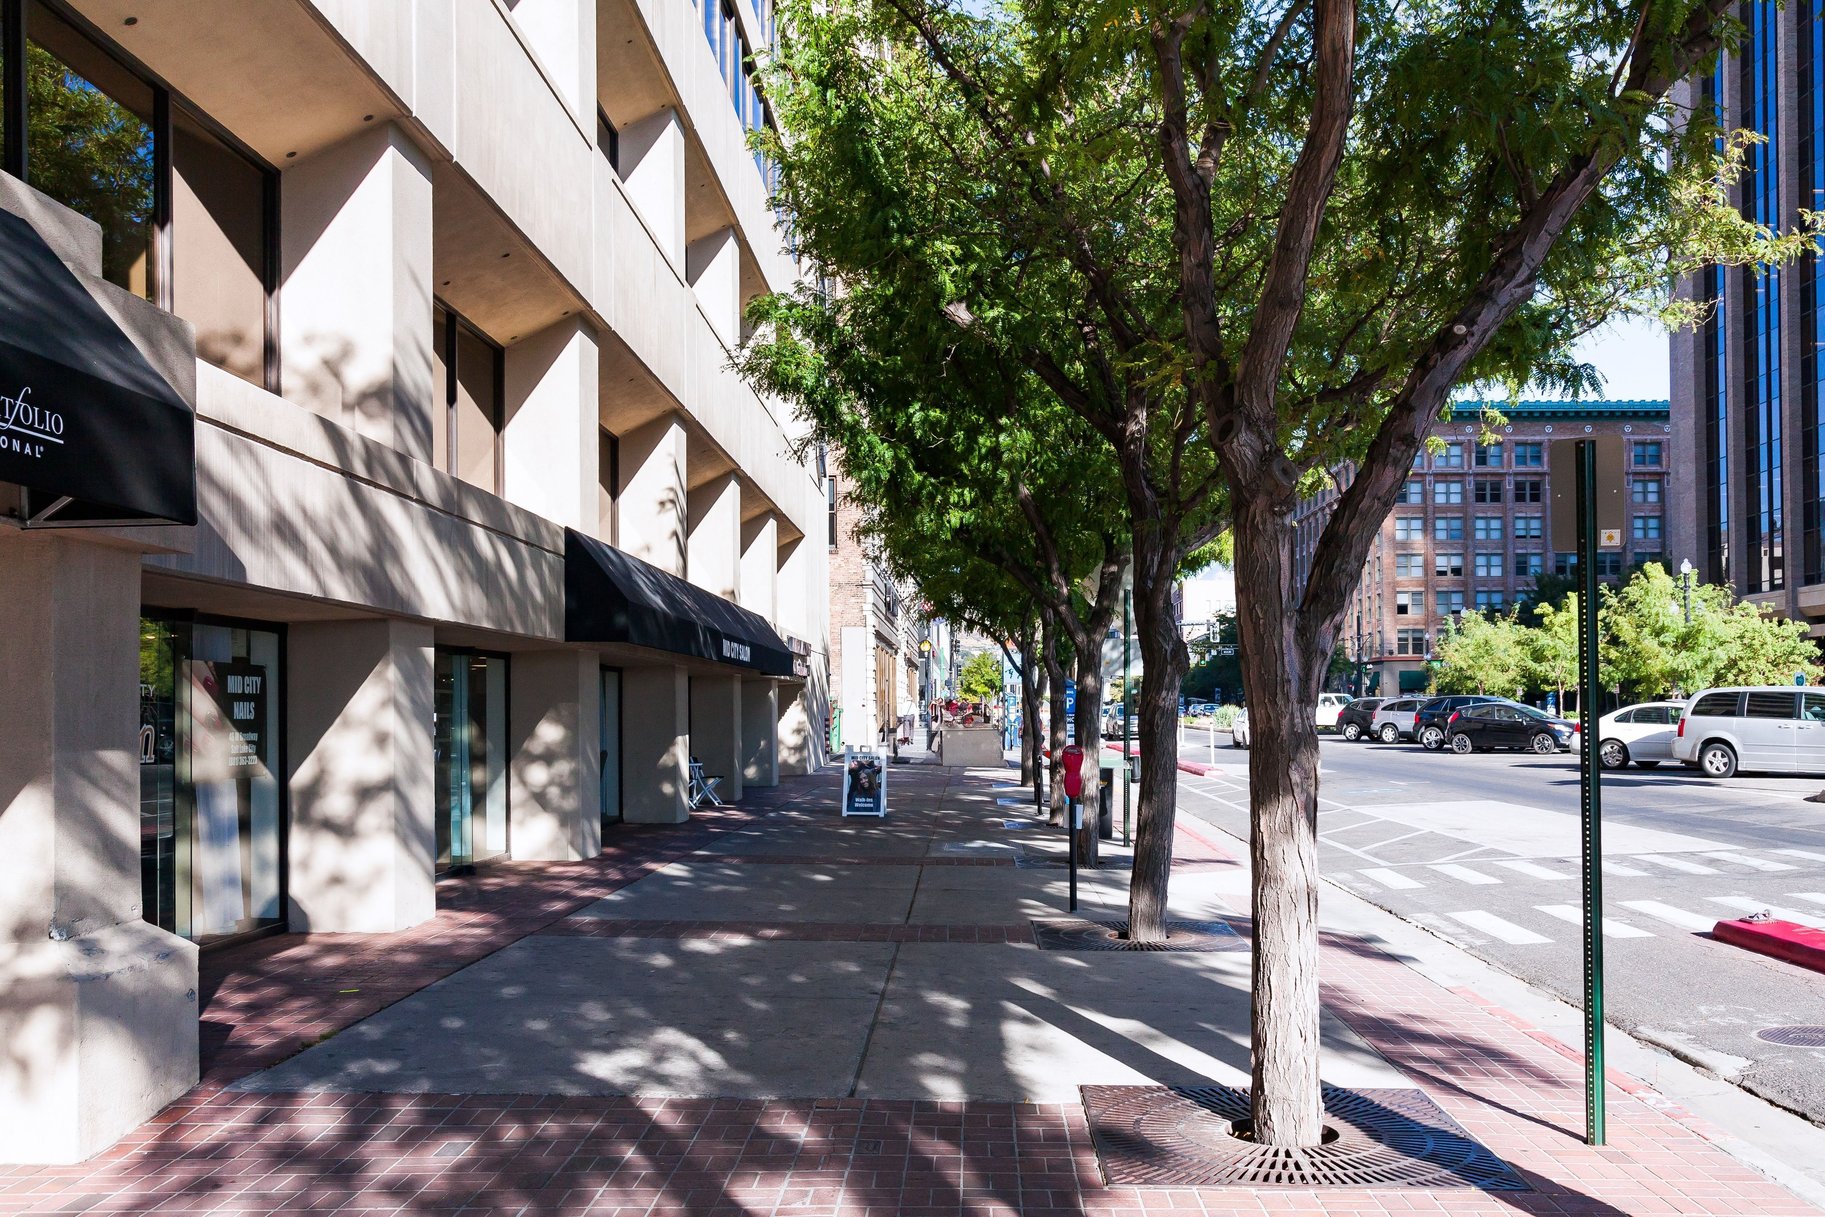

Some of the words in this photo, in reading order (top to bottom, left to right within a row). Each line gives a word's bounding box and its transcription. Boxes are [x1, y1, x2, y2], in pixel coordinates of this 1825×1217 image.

[0, 387, 64, 435] TfOLIO
[731, 641, 739, 660] CITY
[227, 675, 243, 694] MID
[244, 676, 262, 694] CITY
[233, 701, 255, 720] NAILS
[1066, 697, 1075, 709] P
